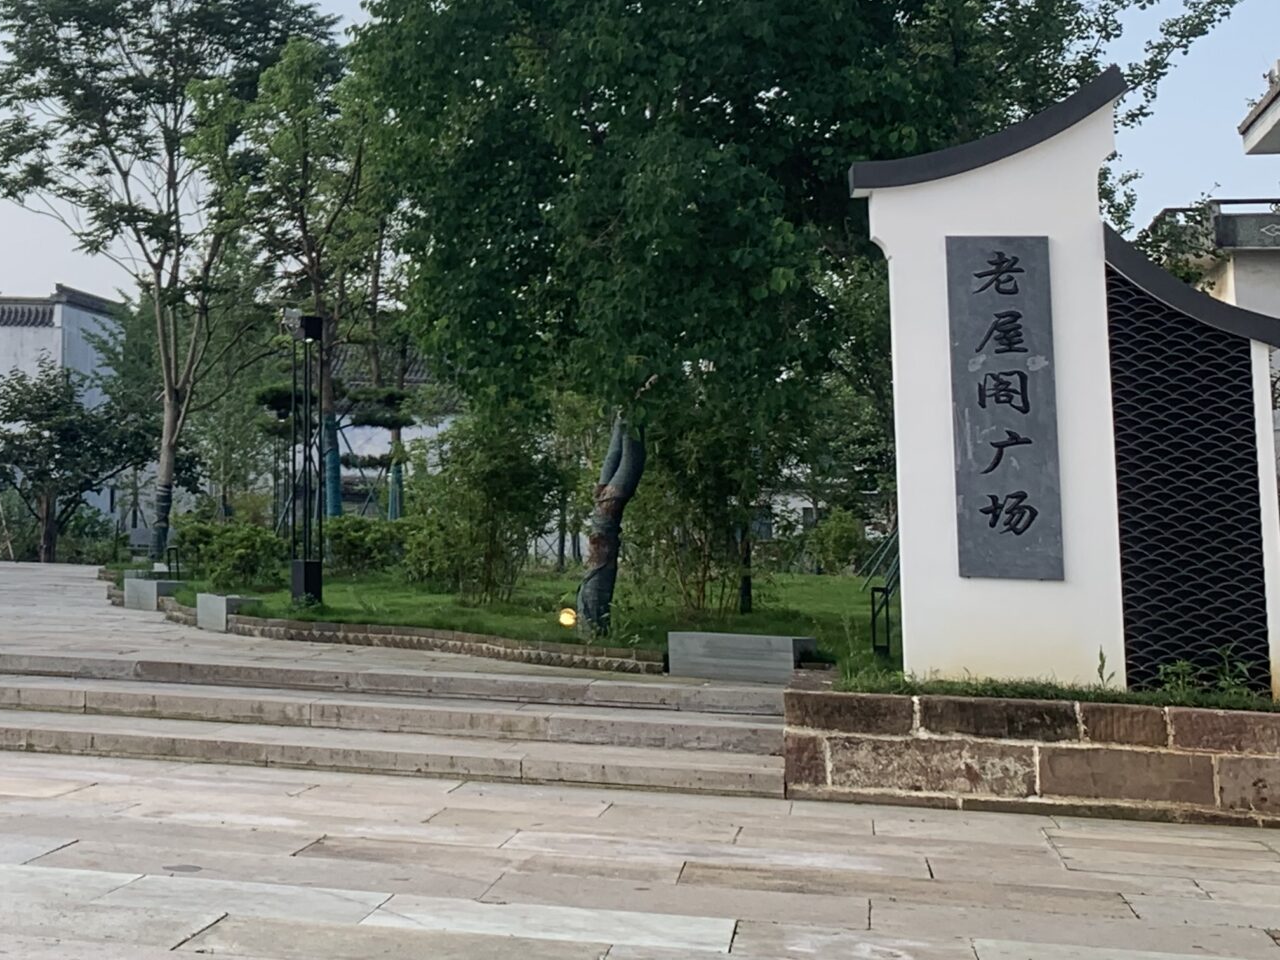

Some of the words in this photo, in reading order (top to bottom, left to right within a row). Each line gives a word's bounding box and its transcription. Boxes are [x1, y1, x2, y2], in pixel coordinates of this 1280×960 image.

[973, 251, 1038, 536] 老屋阁广场
